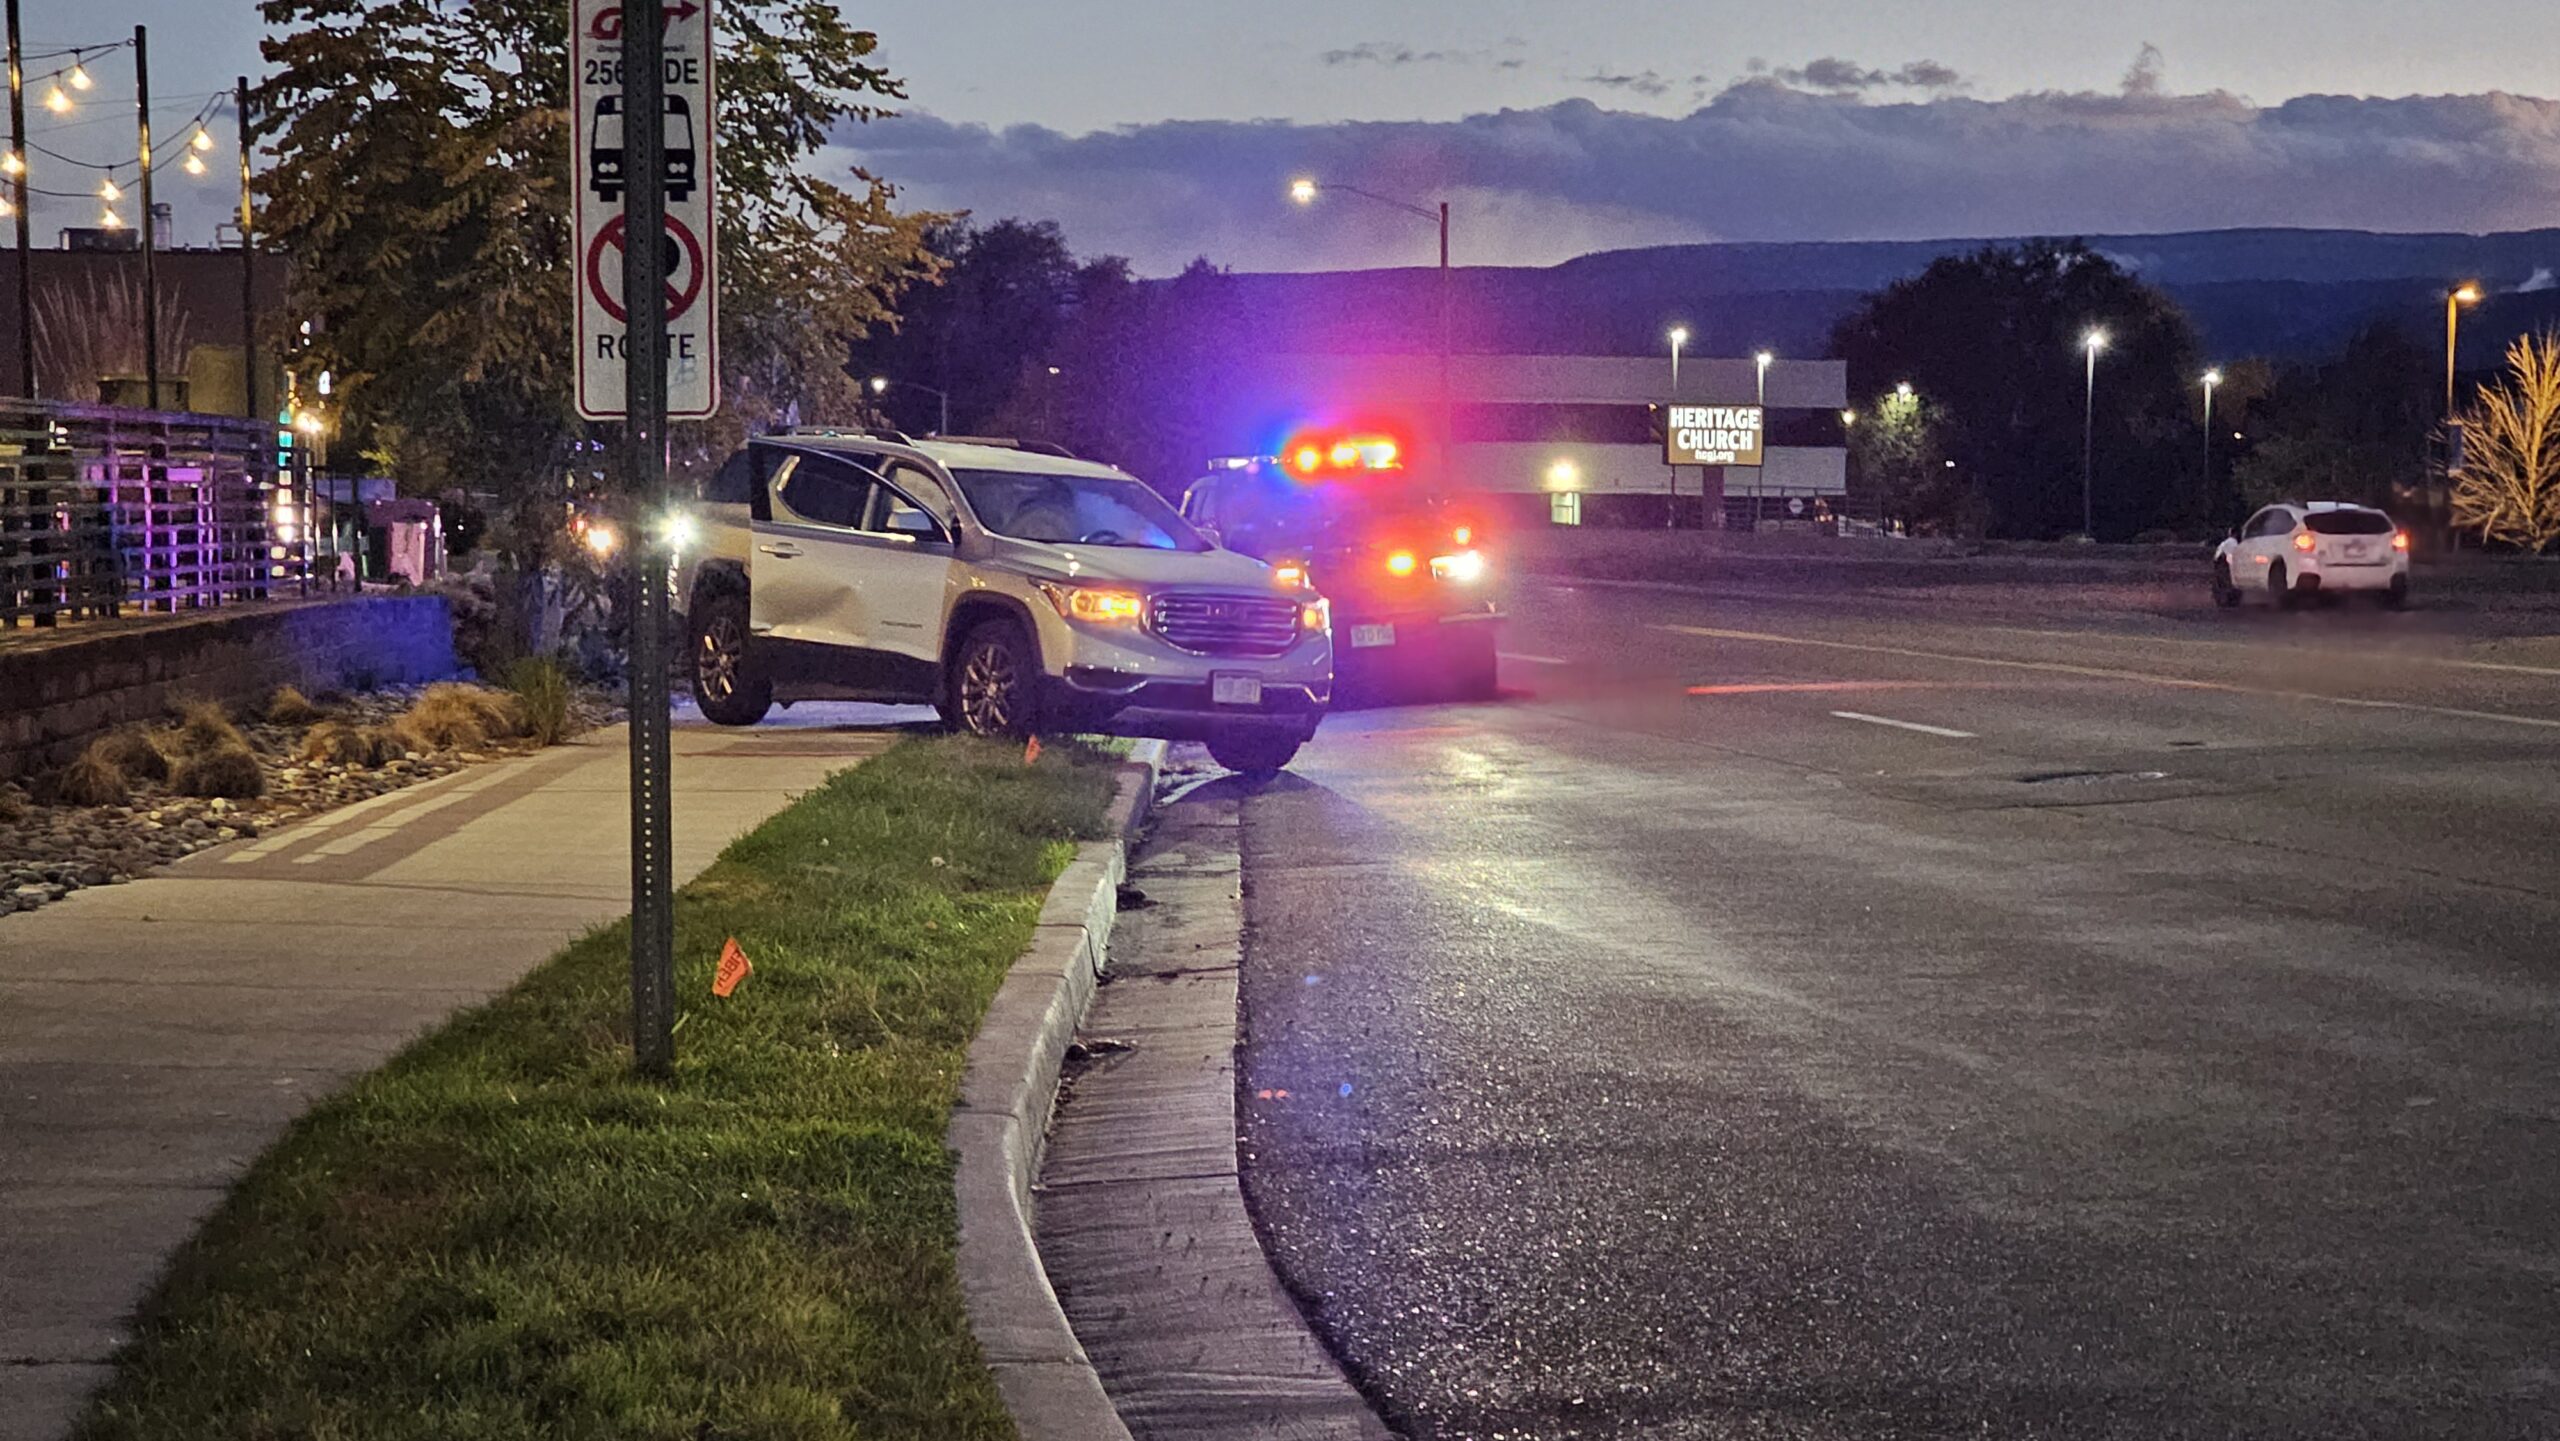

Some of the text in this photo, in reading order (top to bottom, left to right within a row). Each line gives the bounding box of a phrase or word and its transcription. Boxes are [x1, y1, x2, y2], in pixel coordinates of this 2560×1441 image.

[584, 58, 699, 85] 256DE
[597, 333, 695, 360] RTE
[1670, 407, 1761, 430] HERITAGE
[1677, 428, 1754, 450] CHURCH
